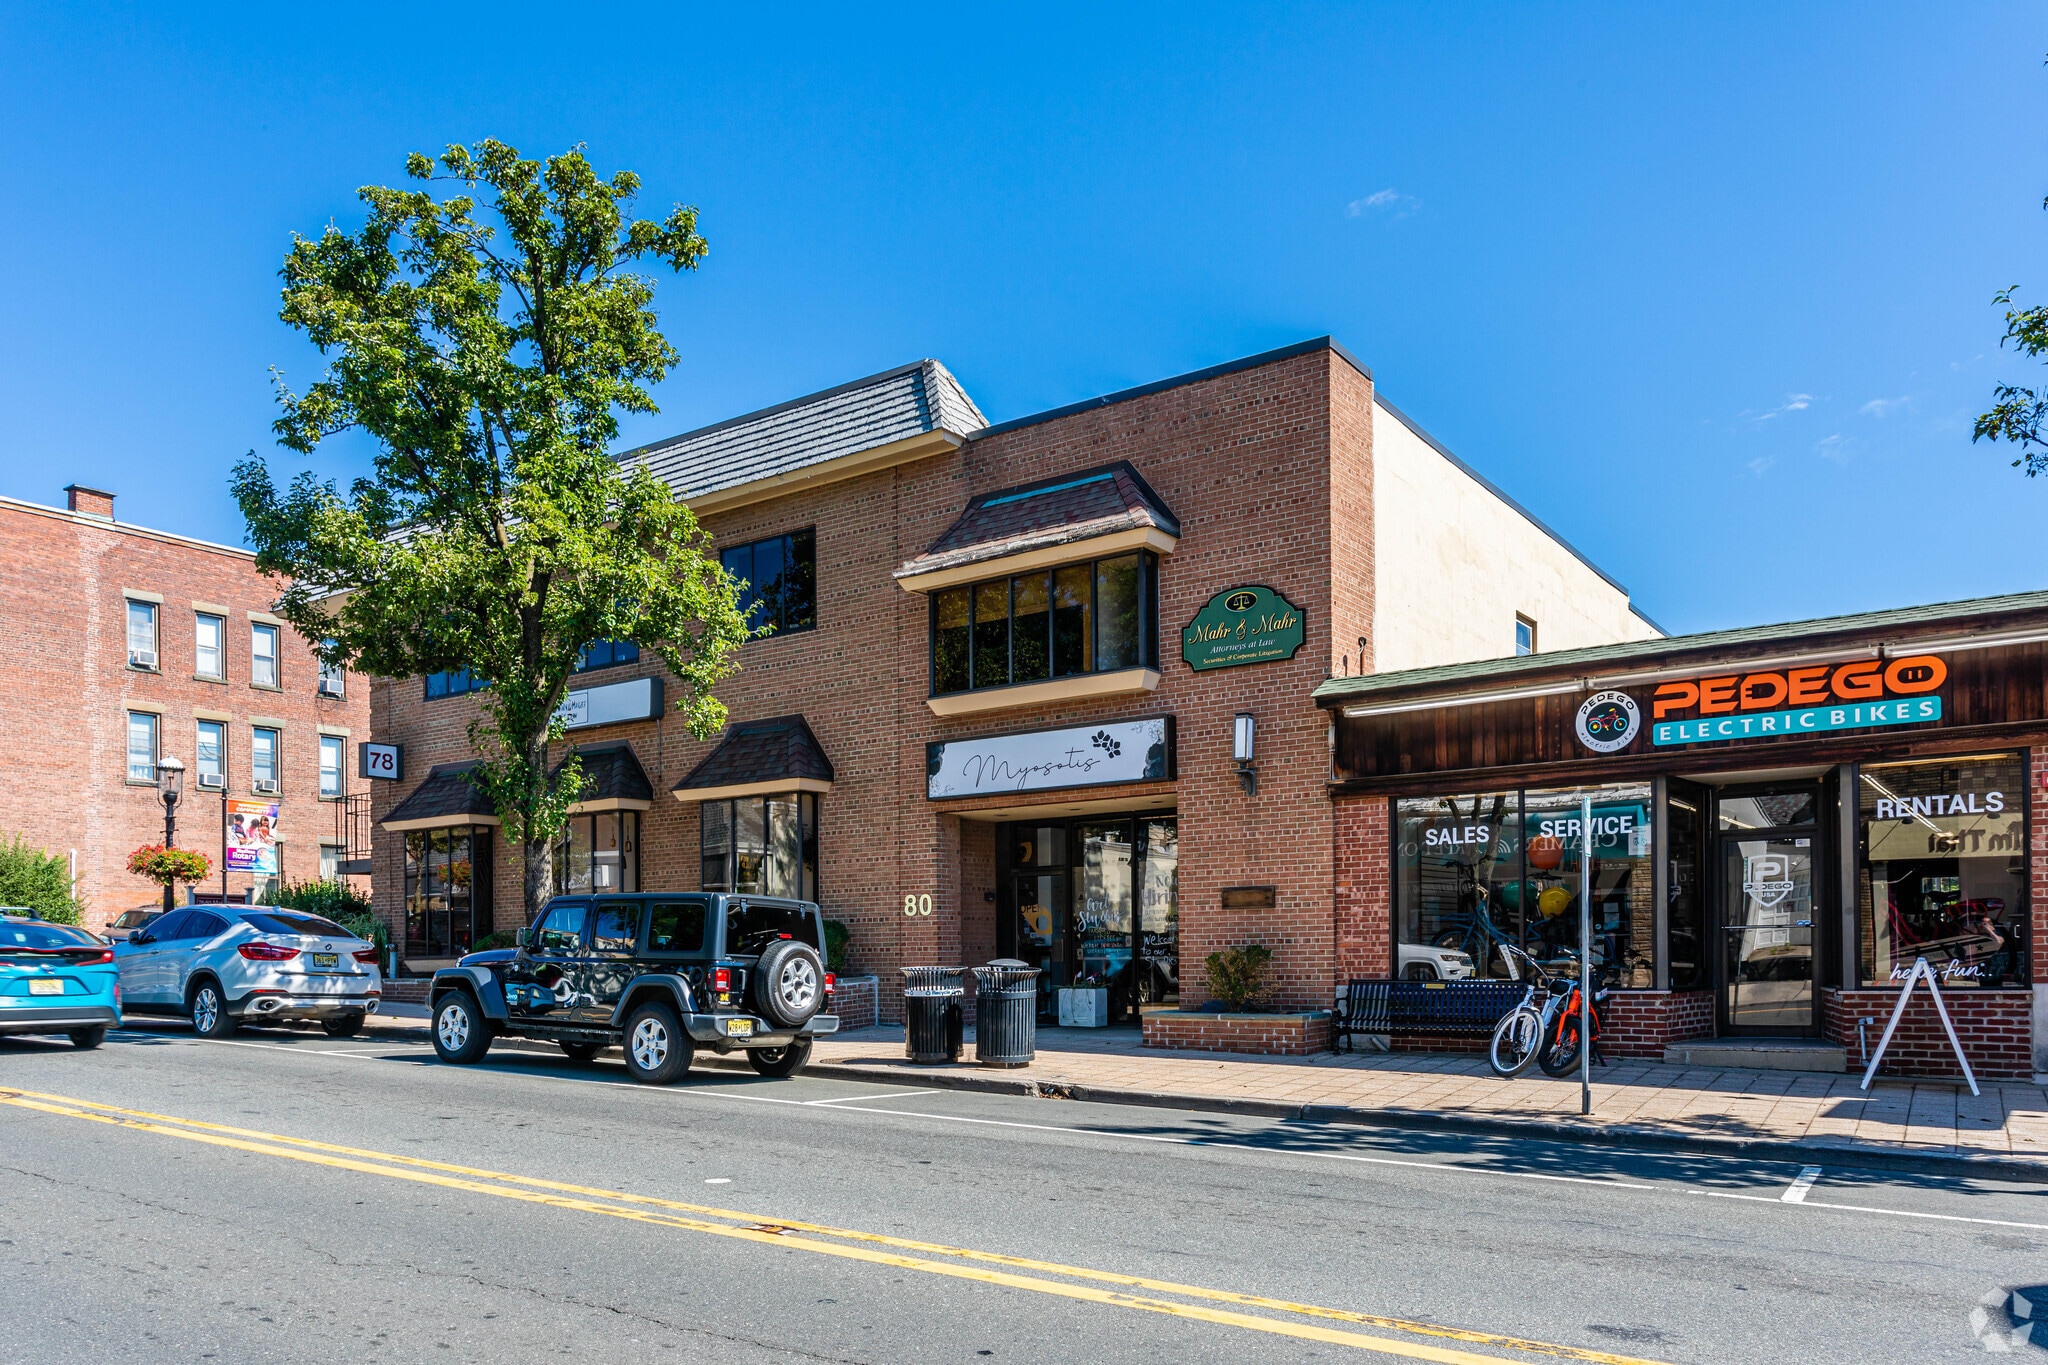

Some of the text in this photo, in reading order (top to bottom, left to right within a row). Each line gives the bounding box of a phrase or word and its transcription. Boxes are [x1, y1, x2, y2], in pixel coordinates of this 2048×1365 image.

[1188, 611, 1297, 645] Mahr & Mahr
[1210, 638, 1276, 654] Attorneys at Law
[1232, 652, 1258, 661] Corporate
[1258, 648, 1283, 657] Litigation
[1653, 655, 1948, 719] PEDEGO
[1580, 693, 1635, 715] PEDEGO
[1659, 700, 1934, 742] ELECTRIC BIKES
[370, 752, 394, 771] 78
[963, 747, 1101, 790] Myosotis
[1876, 791, 2004, 819] RENTALS
[1425, 825, 1490, 846] SALES
[1540, 815, 1633, 839] SERVICE
[232, 851, 256, 861] Rotary
[904, 894, 932, 916] 80
